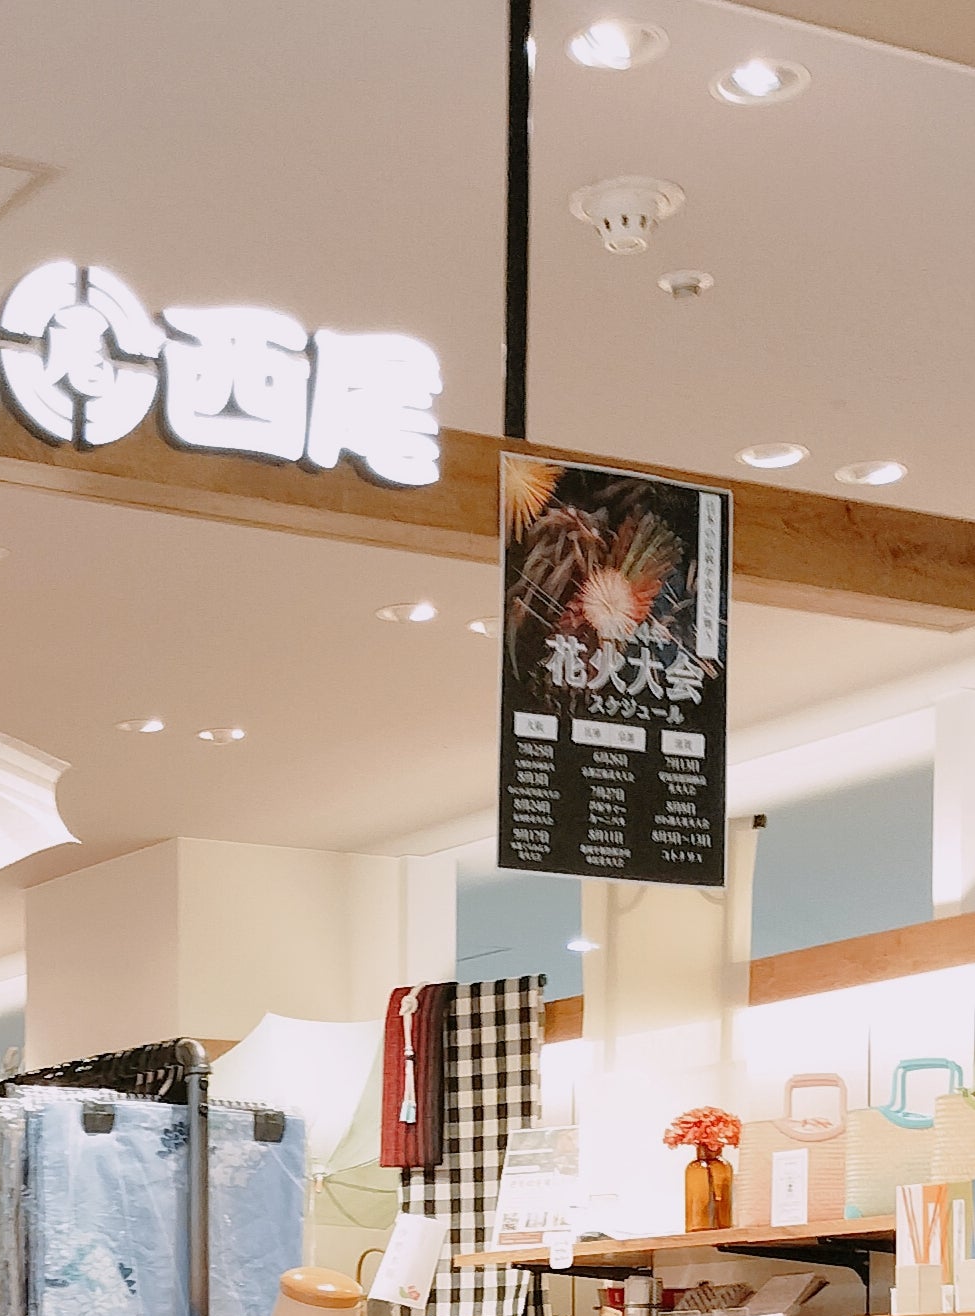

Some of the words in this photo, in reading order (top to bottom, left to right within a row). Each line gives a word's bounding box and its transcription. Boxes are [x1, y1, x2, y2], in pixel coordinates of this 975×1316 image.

[160, 306, 442, 488] 西尾
[545, 634, 704, 705] 花火大会
[588, 695, 685, 725] スケジュール
